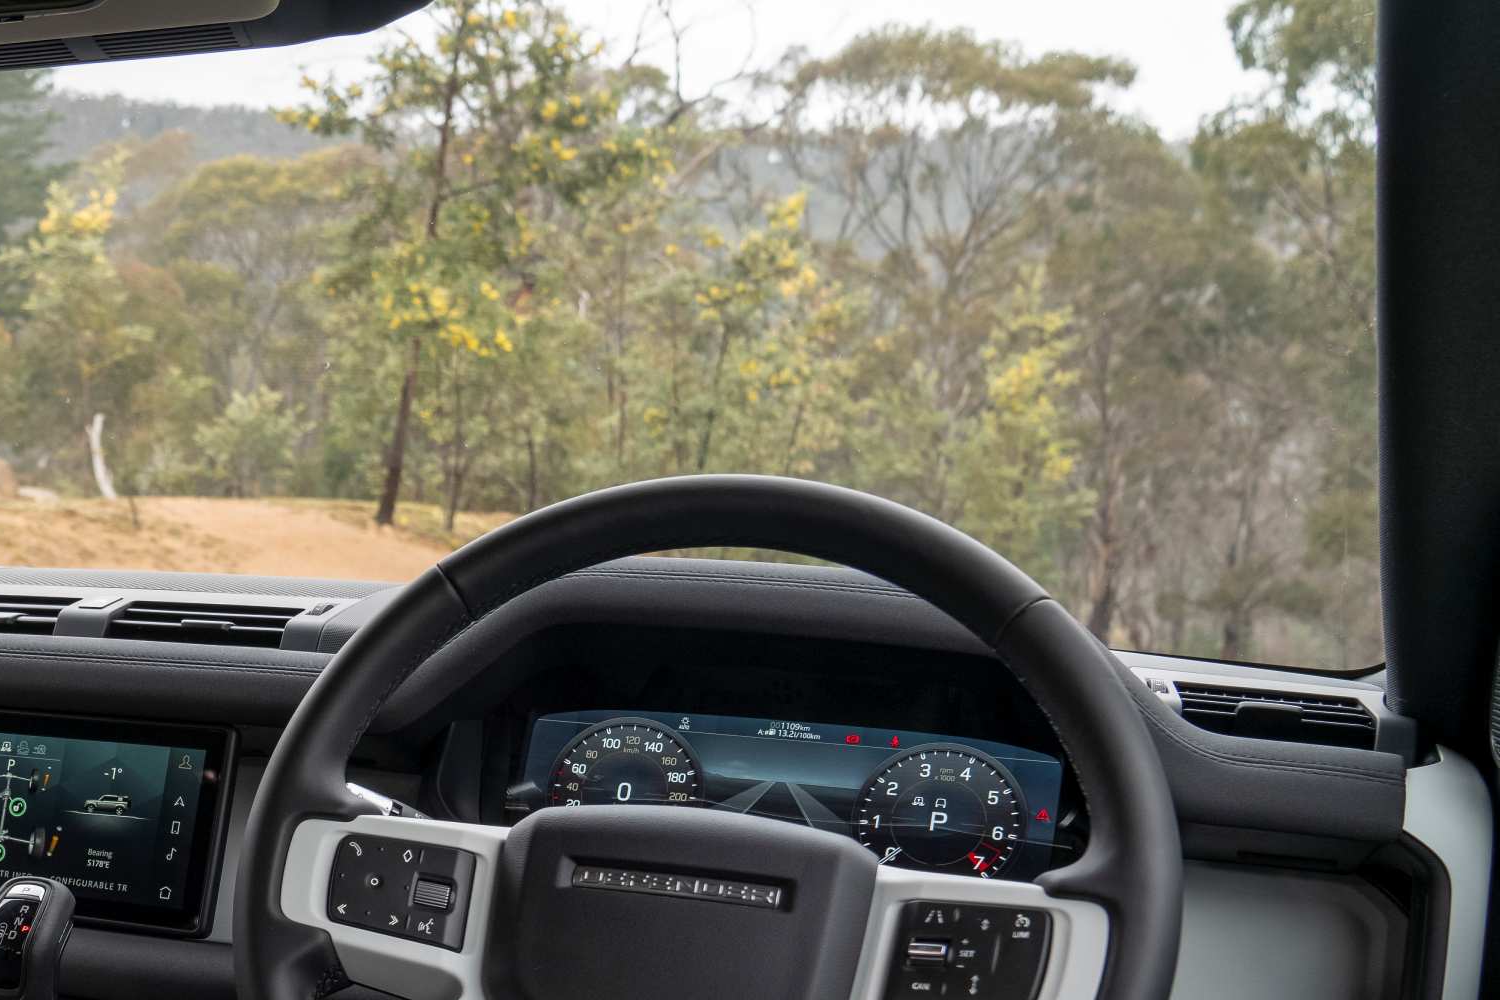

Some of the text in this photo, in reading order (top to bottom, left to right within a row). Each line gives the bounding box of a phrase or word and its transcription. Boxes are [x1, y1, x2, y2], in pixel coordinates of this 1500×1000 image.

[602, 738, 621, 749] 100
[625, 736, 641, 744] 120
[644, 741, 663, 753] 140
[585, 750, 598, 759] 80
[7, 759, 16, 771] P
[661, 757, 677, 766] 160
[571, 763, 587, 774] 60
[919, 763, 932, 778] 3
[959, 767, 972, 781] 4
[666, 772, 687, 784] 180
[566, 782, 579, 792] 40
[617, 782, 632, 802] 0
[886, 781, 899, 796] 2
[668, 792, 688, 802] 200
[987, 790, 1000, 805] 5
[872, 814, 881, 829] 1
[929, 811, 948, 831] P
[991, 826, 1004, 841] 6
[87, 848, 113, 860] Bearing
[972, 855, 986, 870] 7
[117, 883, 129, 892] TR
[19, 904, 31, 914] R
[13, 916, 24, 926] N
